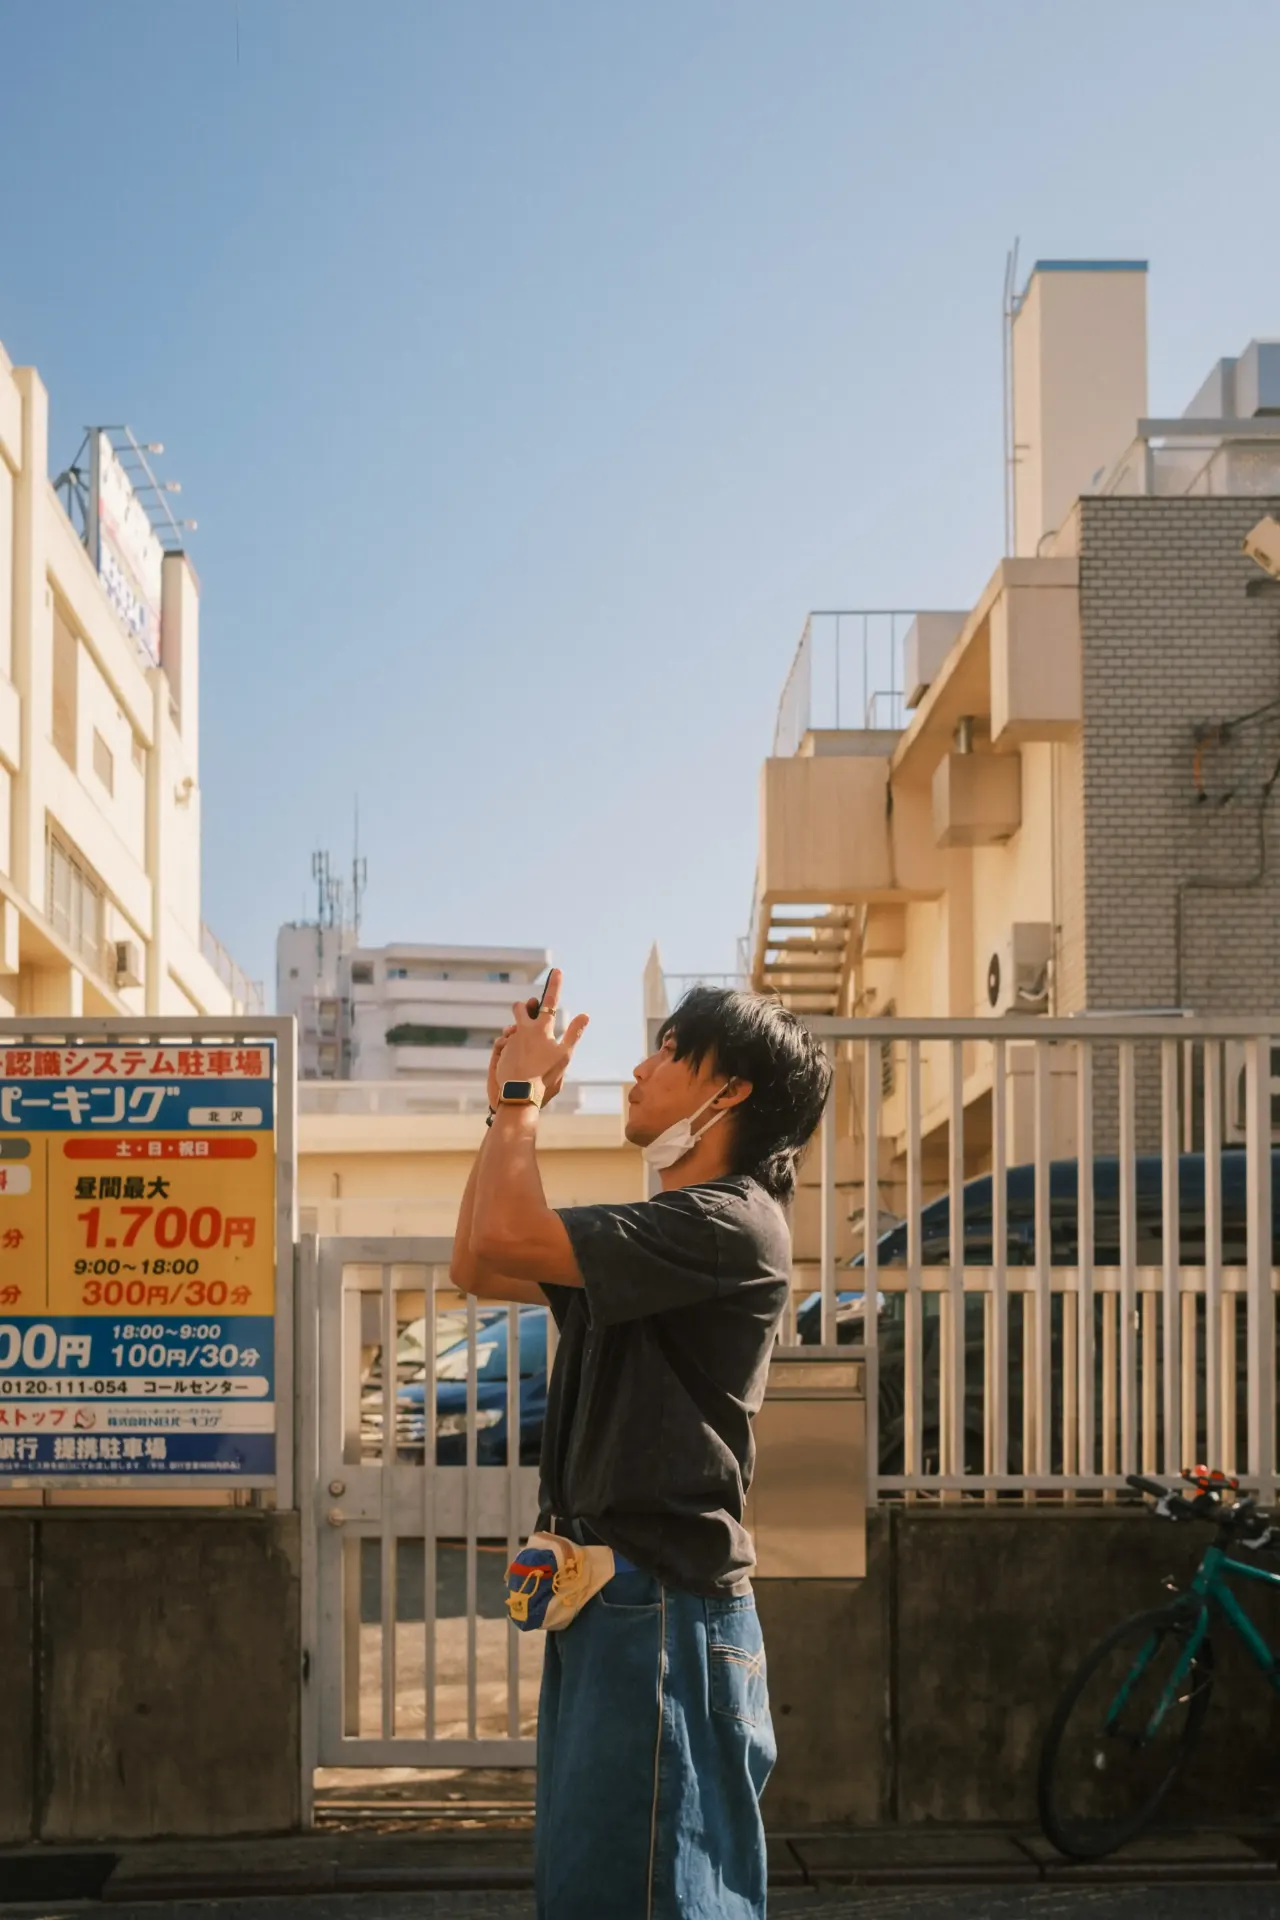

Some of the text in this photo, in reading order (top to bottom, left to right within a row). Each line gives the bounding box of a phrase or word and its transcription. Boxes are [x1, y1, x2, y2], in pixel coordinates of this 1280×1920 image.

[0, 1050, 263, 1077] 認識システム駐車場
[74, 1176, 170, 1200] 昼間最大
[82, 1279, 253, 1307] 300円/30分
[111, 1344, 261, 1369] 100円/30分
[143, 1380, 249, 1395] コールセンター
